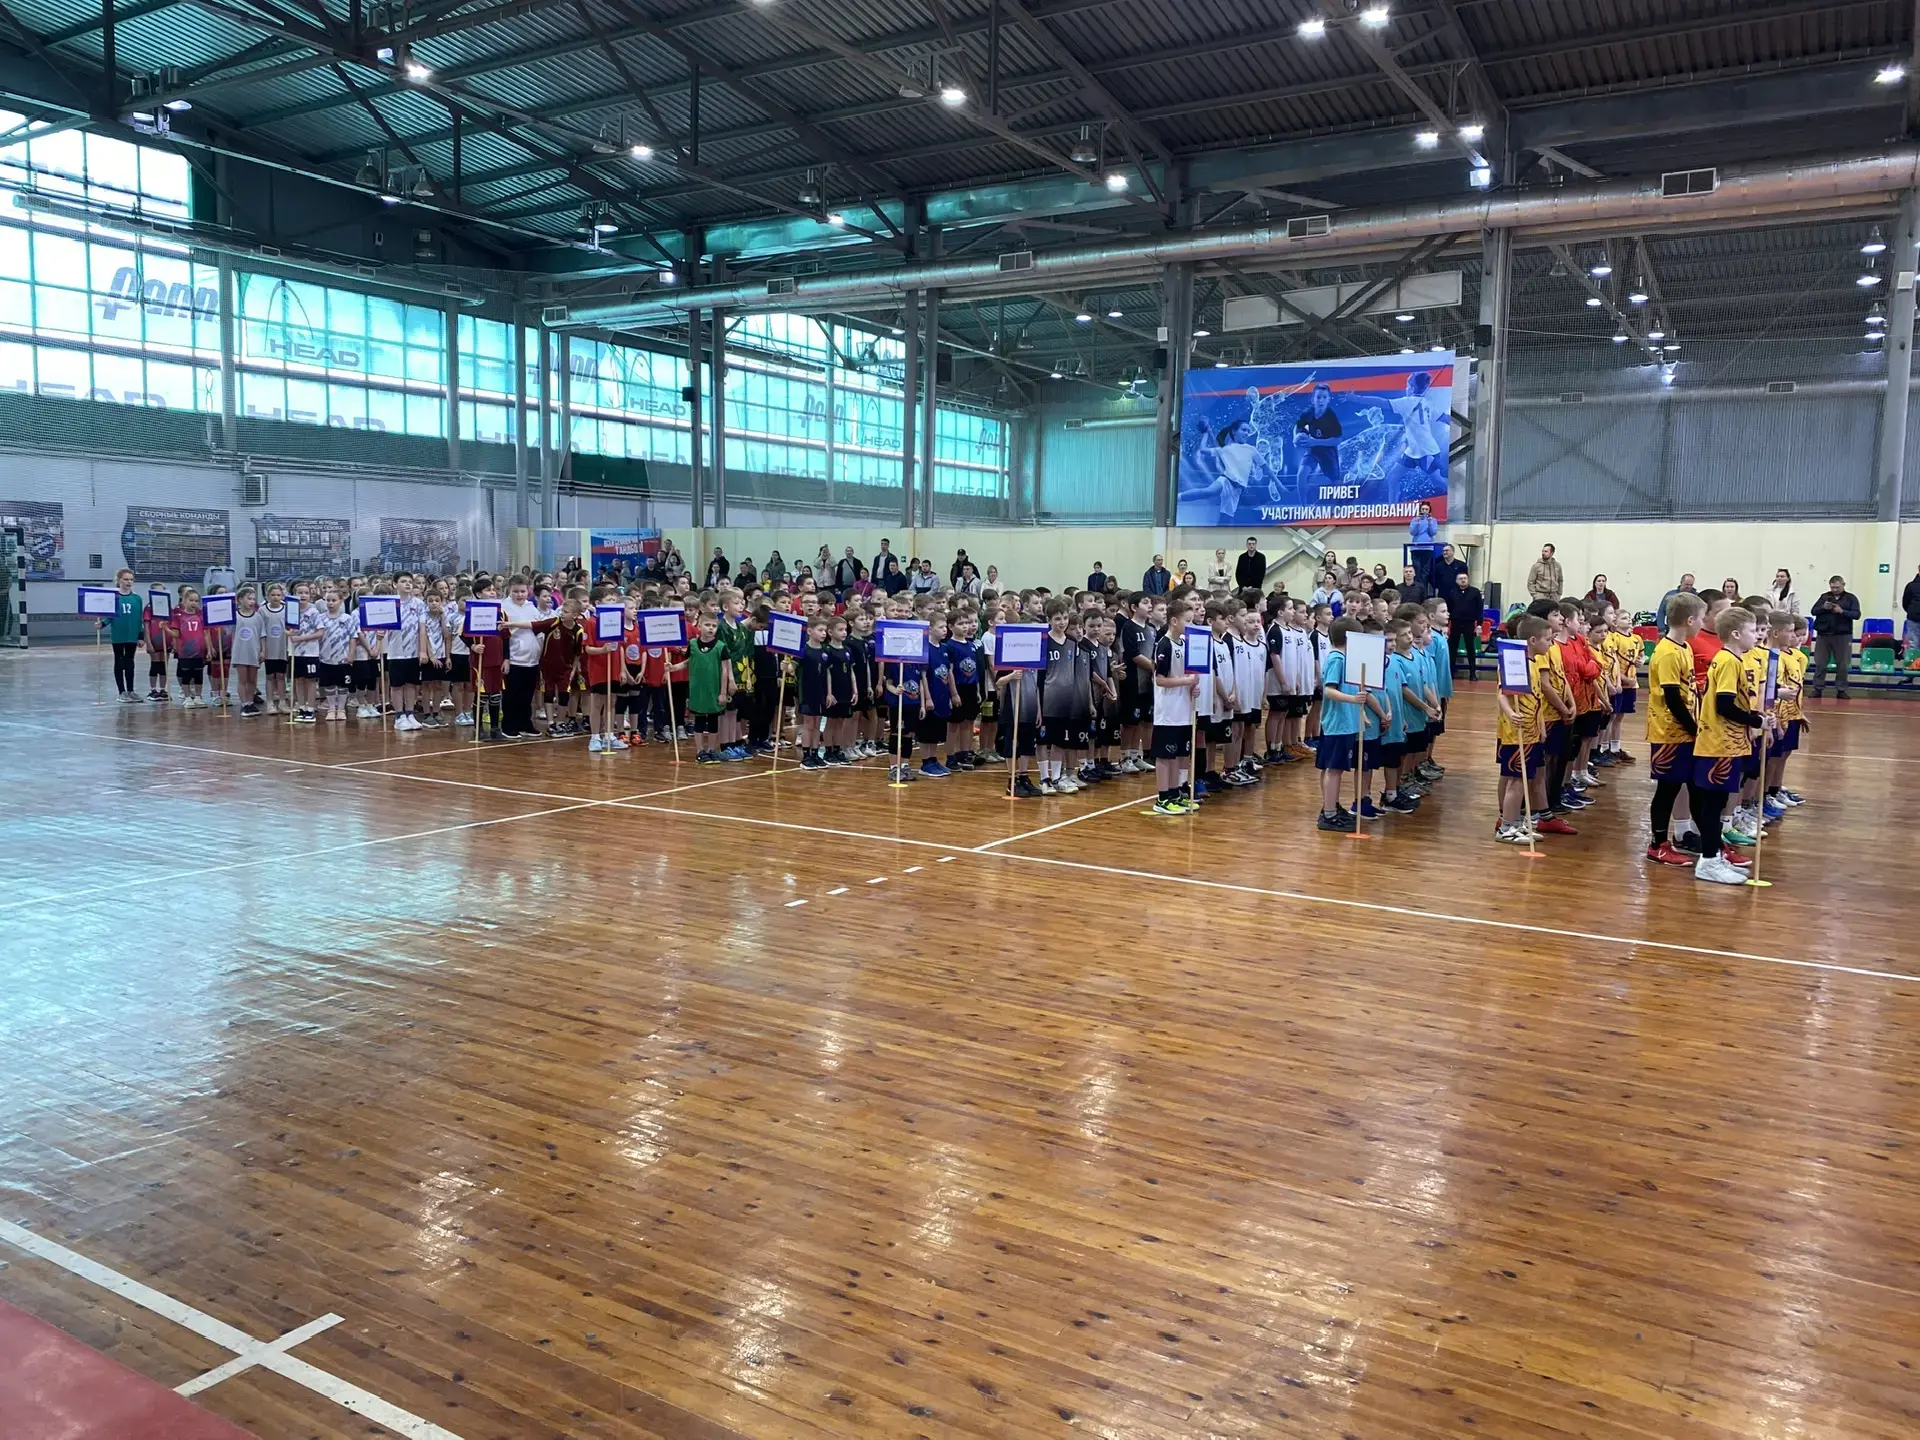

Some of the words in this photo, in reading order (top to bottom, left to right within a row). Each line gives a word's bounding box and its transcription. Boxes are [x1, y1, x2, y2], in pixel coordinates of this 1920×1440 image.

[269, 338, 360, 367] HEAD
[629, 396, 687, 416] HEAD
[863, 435, 901, 448] HEAD
[1319, 485, 1361, 500] ПРИВЕТ
[139, 511, 180, 519] СБОРНЫЕ
[181, 512, 220, 520] КОМАНДЫ
[1261, 505, 1331, 520] УЧАСТНИКАМ
[1334, 500, 1420, 518] СОРЕВНОВАНИЙ
[122, 603, 132, 614] 12
[187, 621, 199, 632] 17
[1136, 632, 1145, 642] 11
[1049, 650, 1060, 661] 10
[307, 664, 317, 674] 10
[344, 675, 351, 684] 2
